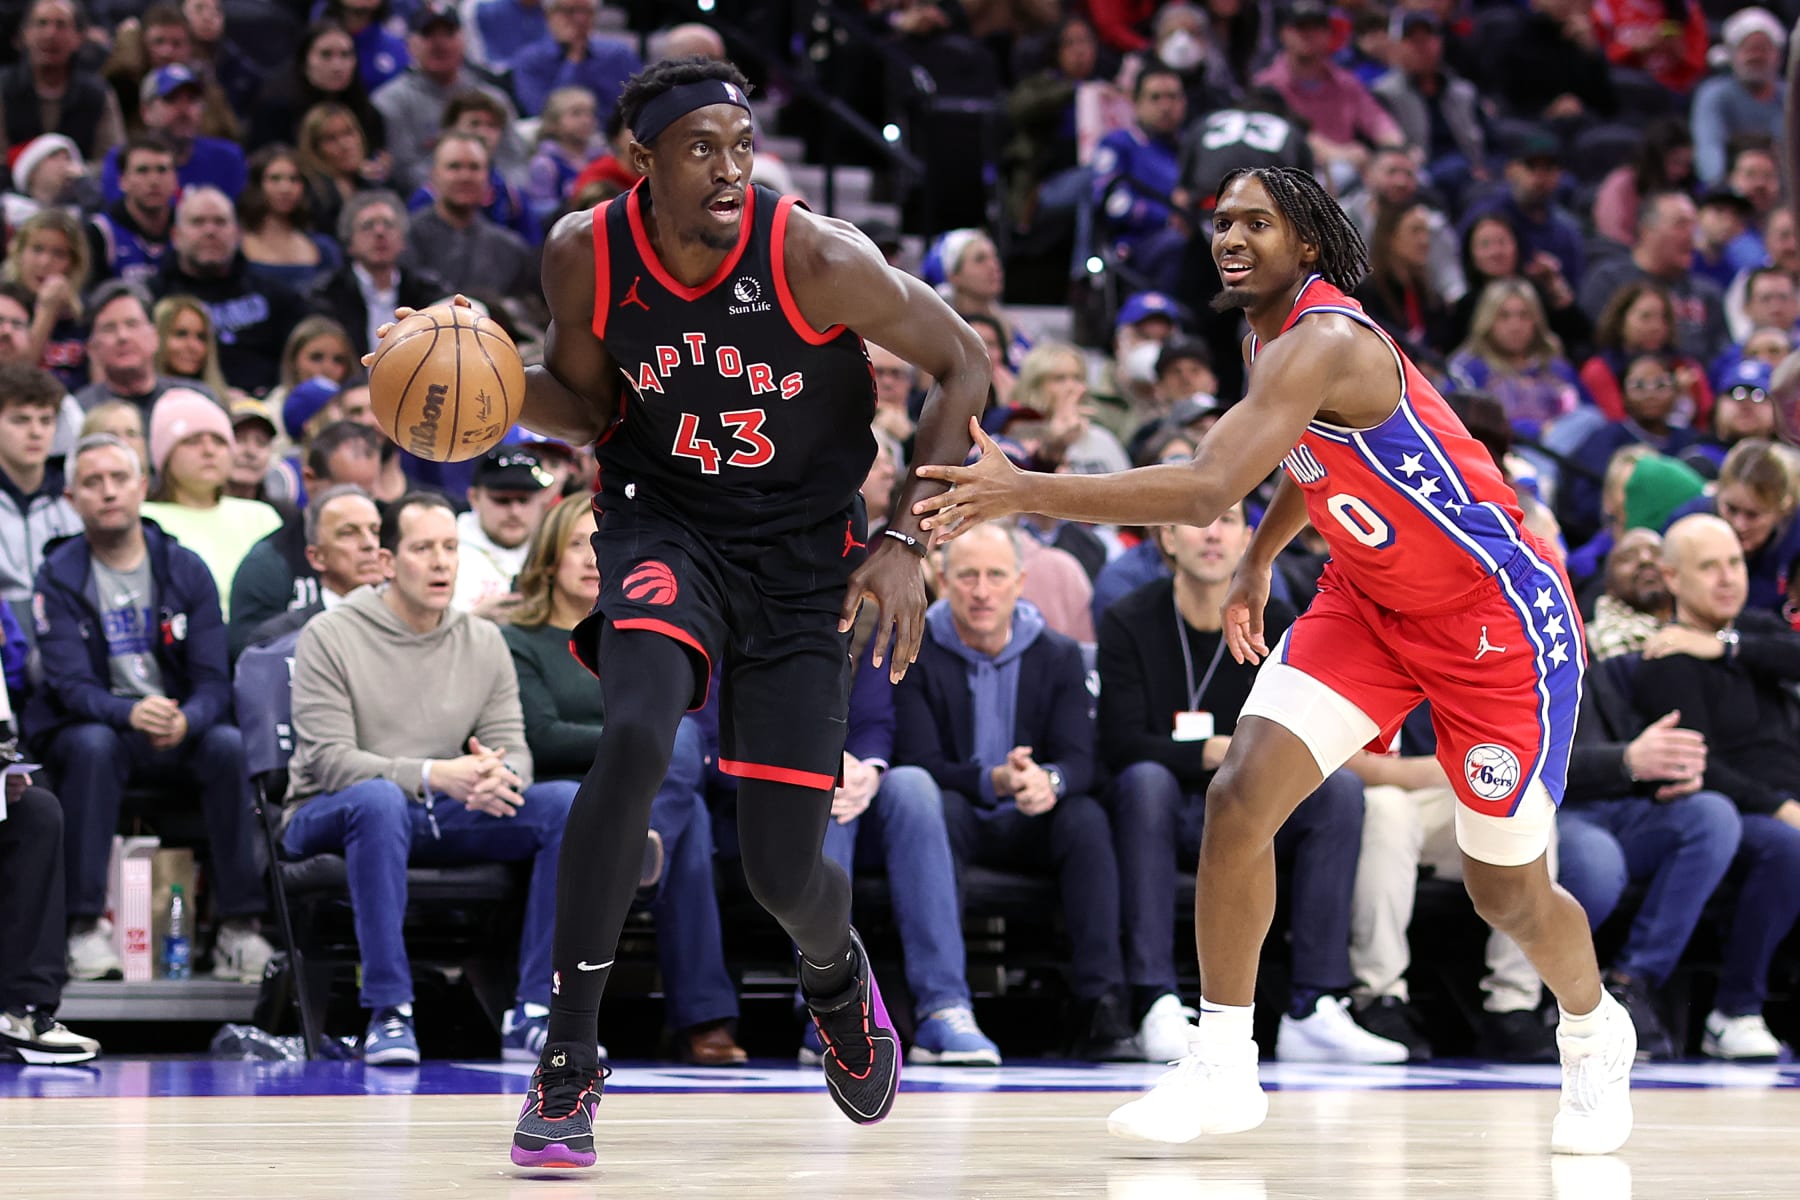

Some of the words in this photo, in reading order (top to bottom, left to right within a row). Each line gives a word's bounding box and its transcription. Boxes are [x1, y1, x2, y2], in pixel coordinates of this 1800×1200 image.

[728, 305, 750, 315] Sun
[751, 301, 772, 312] Life
[671, 408, 776, 474] 43
[1326, 492, 1396, 551] 0
[1469, 760, 1513, 788] 76ers
